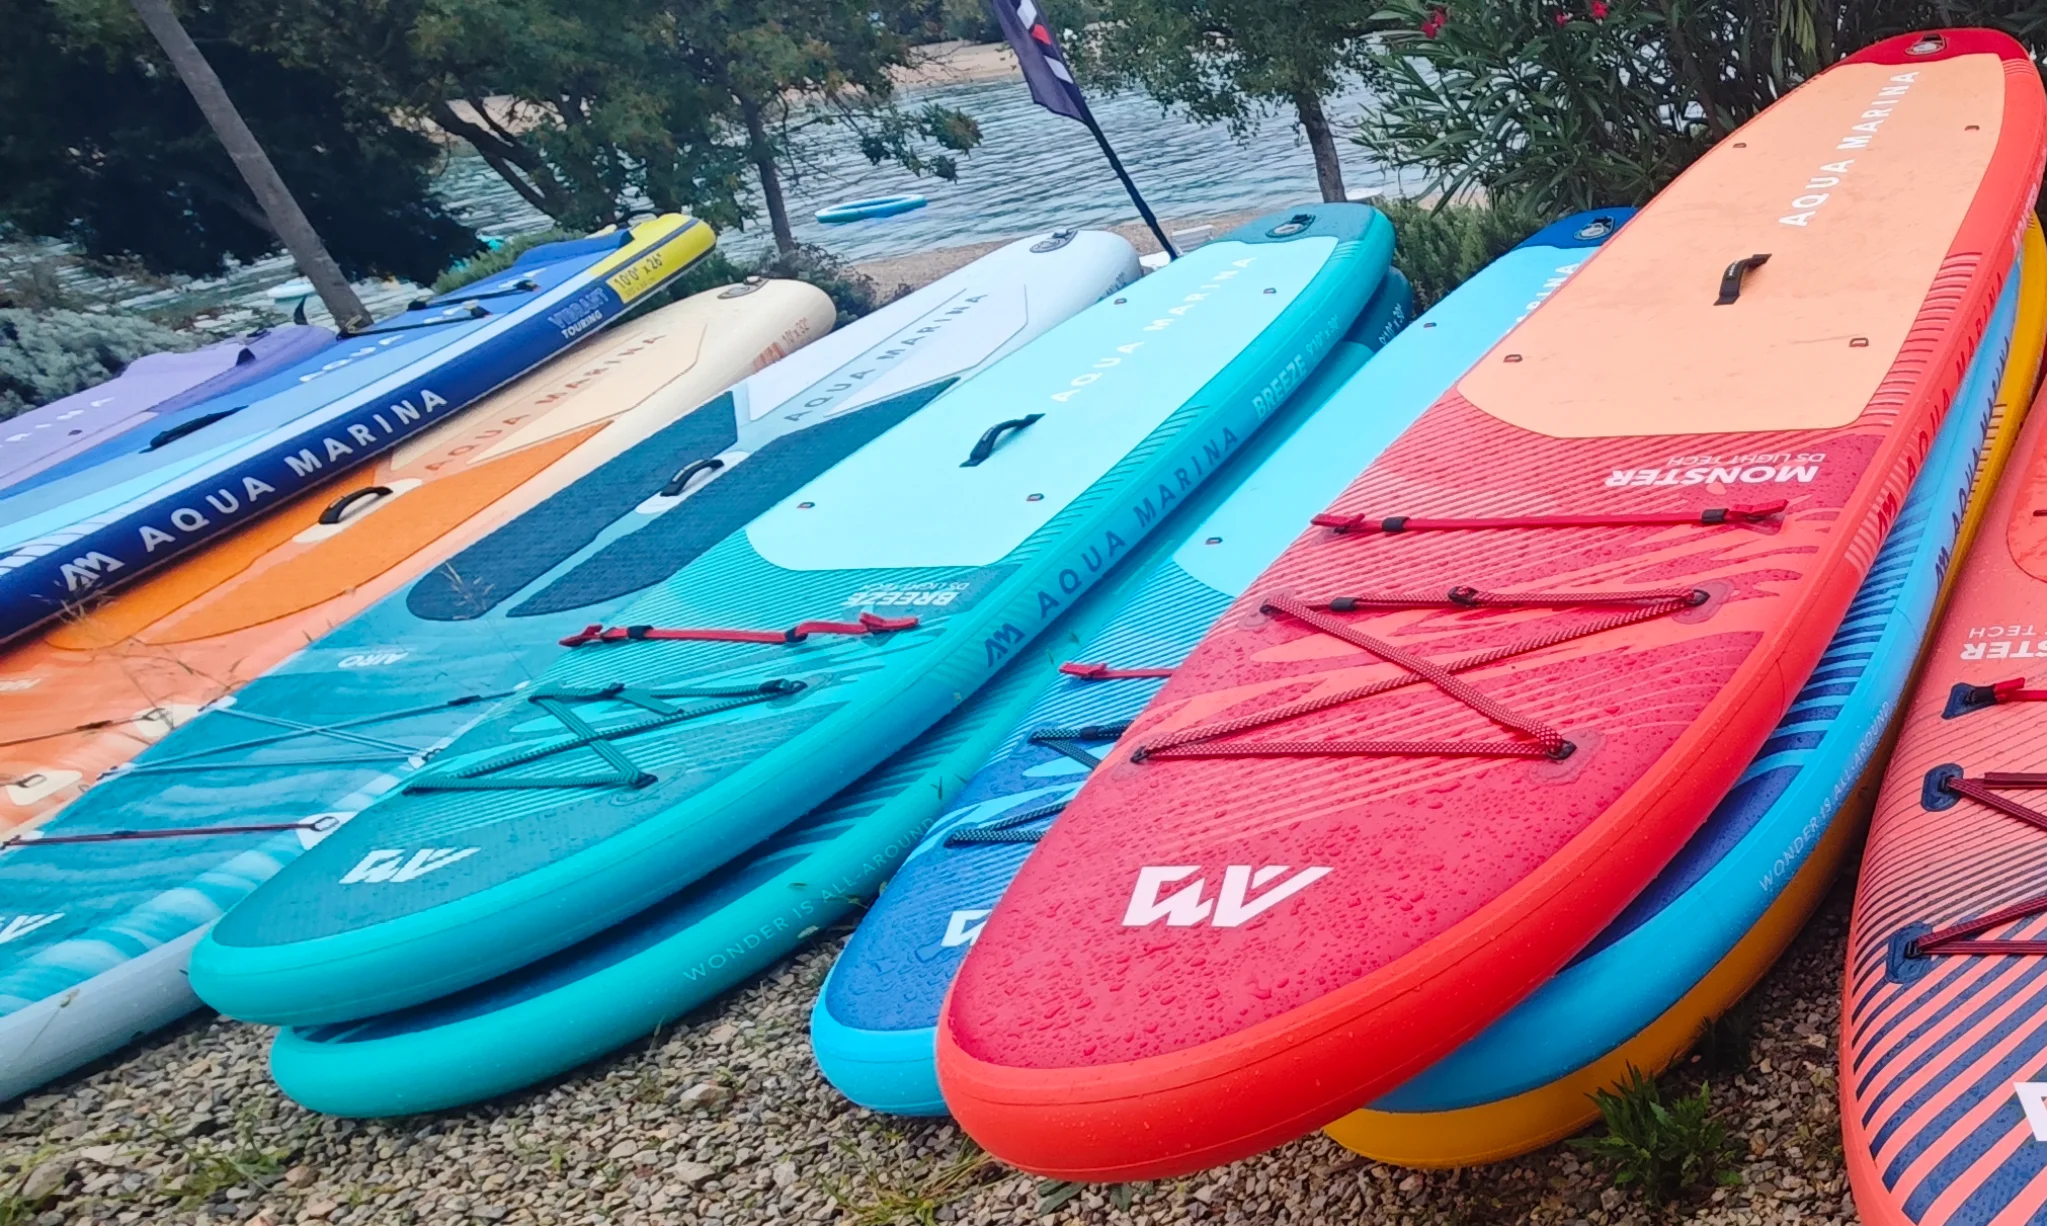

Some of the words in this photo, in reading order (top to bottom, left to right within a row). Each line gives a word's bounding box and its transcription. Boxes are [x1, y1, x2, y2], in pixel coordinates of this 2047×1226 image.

[1778, 158, 1855, 227] AQUA
[1836, 71, 1920, 150] MARINA
[561, 309, 603, 339] TOURING
[784, 368, 875, 421] AQUA
[876, 293, 989, 360] MARINA
[1051, 340, 1144, 403] AQUA
[1143, 256, 1258, 332] MARINA
[424, 413, 530, 471] AQUA
[535, 333, 666, 405] MARINA
[1251, 353, 1308, 420] BREEZE
[138, 475, 275, 552] AQUA
[283, 389, 447, 477] MARINA
[1604, 465, 1820, 488] MONSTER
[1667, 455, 1719, 466] TECH
[1722, 453, 1790, 465] LIGHT
[1795, 453, 1826, 464] DS
[1034, 529, 1128, 619] AQUA
[1131, 425, 1239, 529] MARINA
[845, 591, 959, 605] BREEZE
[1968, 624, 2036, 639] TECH
[1758, 815, 1819, 892] WONDER
[1820, 796, 1833, 820] IS
[1831, 700, 1892, 811] ALL-AROUND
[683, 916, 789, 983] WONDER
[796, 901, 816, 920] IS
[820, 816, 936, 905] ALL-AROUND
